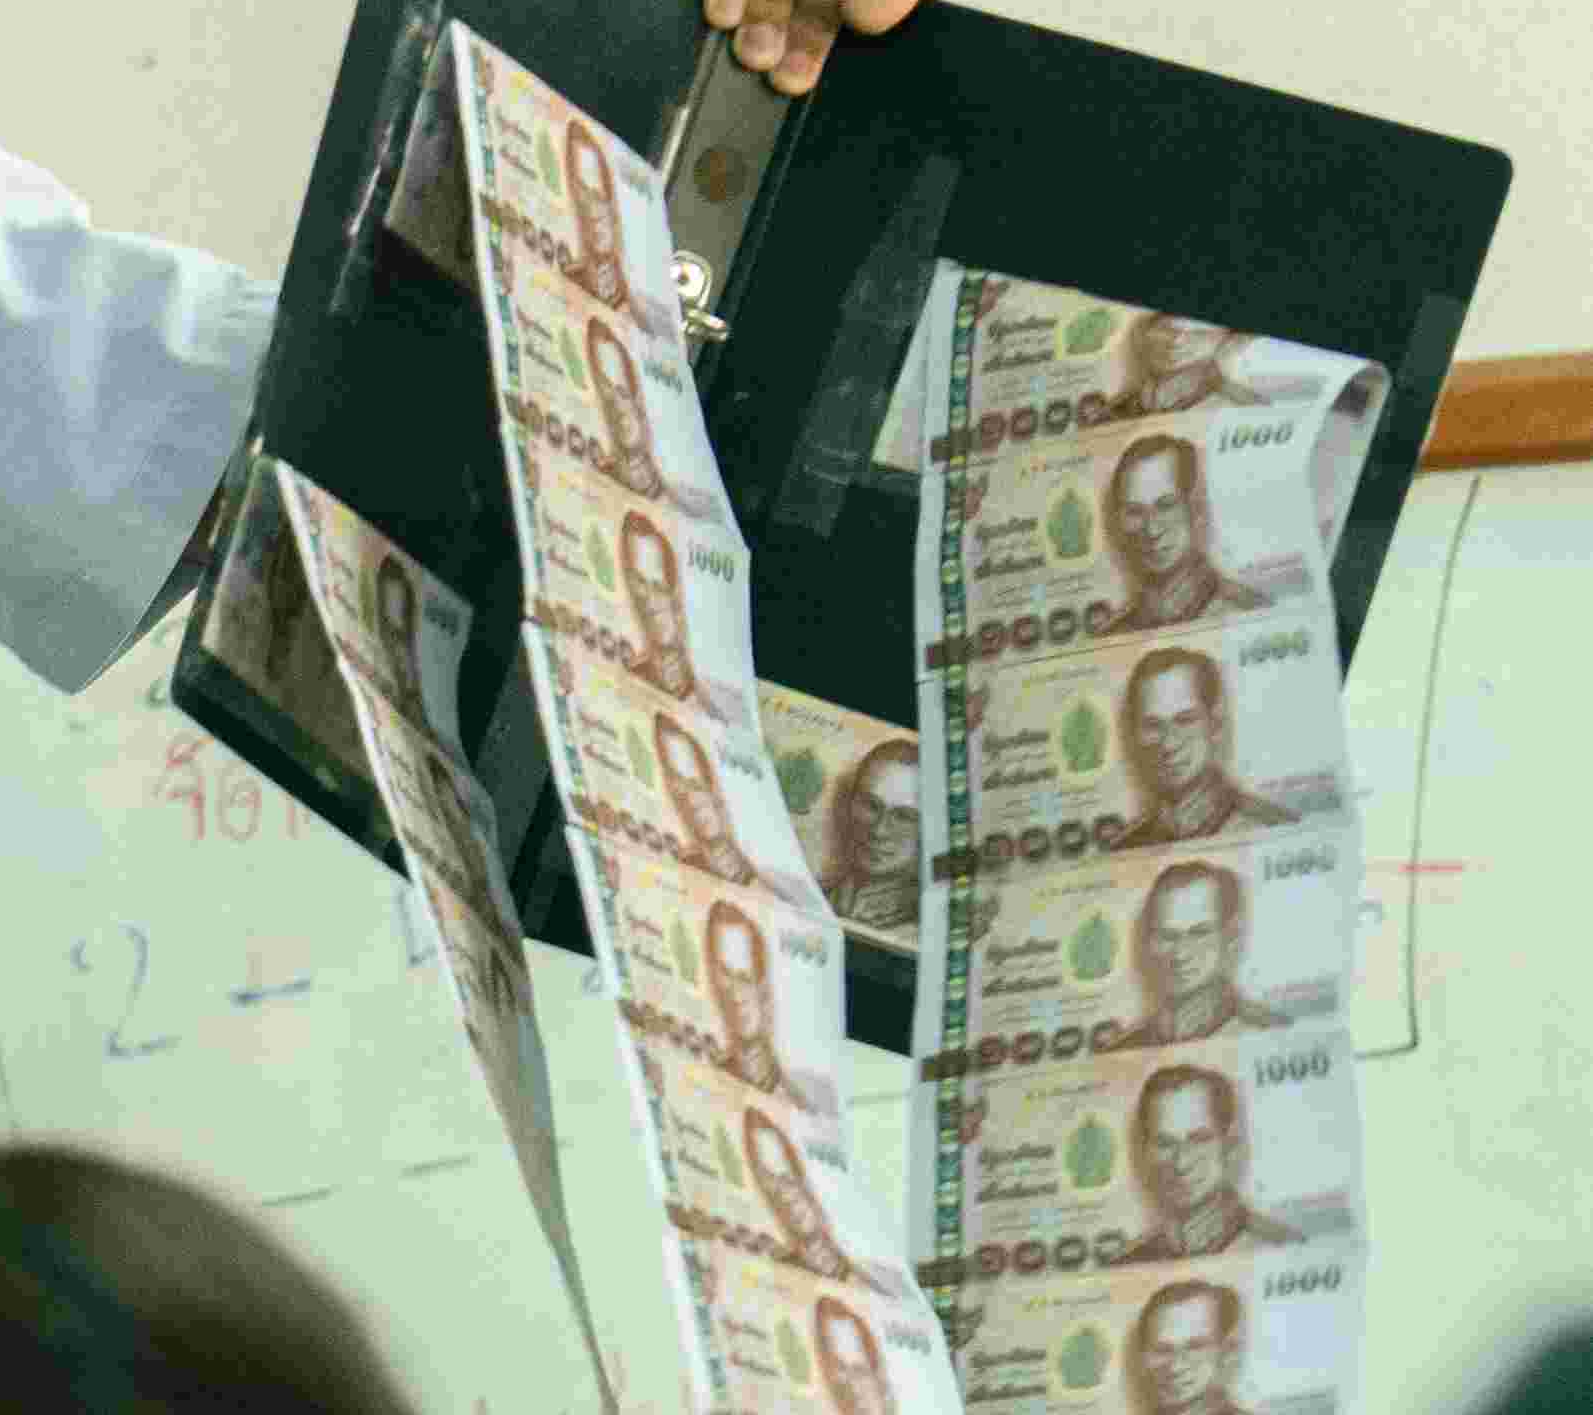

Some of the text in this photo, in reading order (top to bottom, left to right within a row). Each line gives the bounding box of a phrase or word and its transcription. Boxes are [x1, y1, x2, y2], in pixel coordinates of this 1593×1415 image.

[1216, 422, 1294, 455] 1000
[685, 543, 736, 585] 1000
[1238, 629, 1311, 666] 1000
[1253, 1049, 1332, 1086] 1000
[1261, 1264, 1342, 1299] 1000
